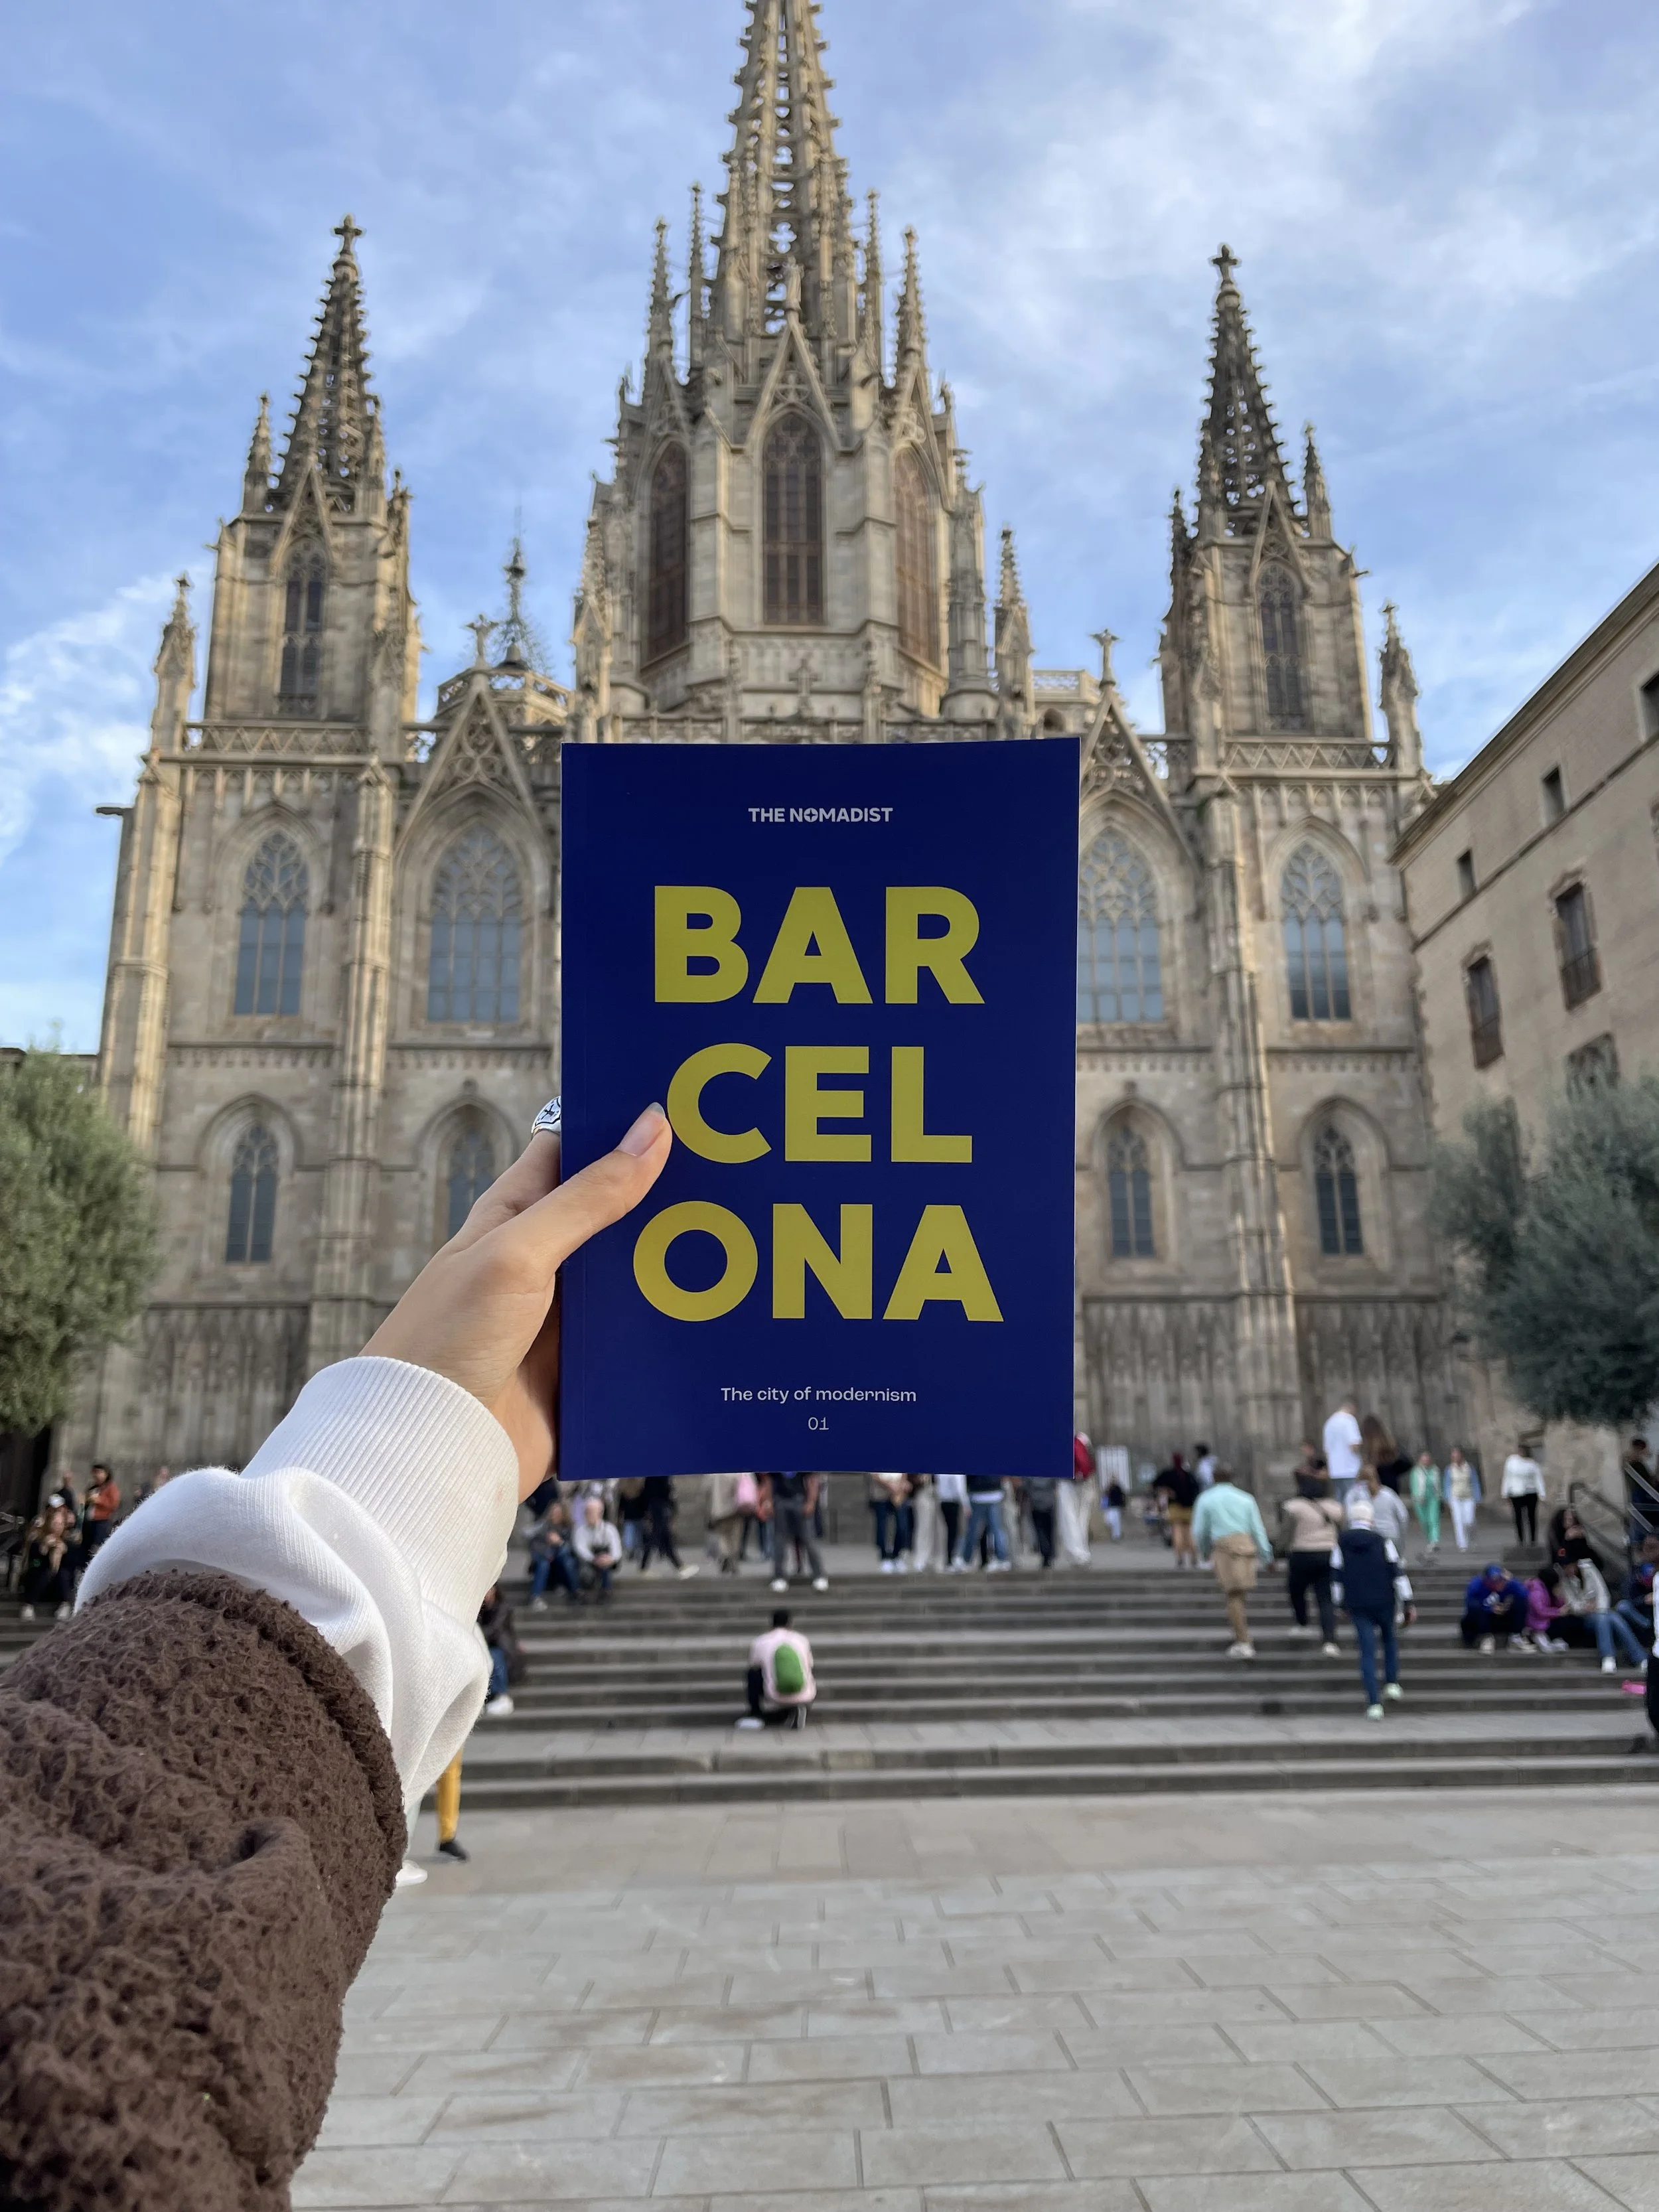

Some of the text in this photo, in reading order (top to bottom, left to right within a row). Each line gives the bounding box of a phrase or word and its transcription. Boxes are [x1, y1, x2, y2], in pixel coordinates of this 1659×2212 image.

[748, 807, 893, 823] THE NOMADIST
[654, 885, 985, 1004] BAR
[666, 1043, 973, 1163] CEL
[633, 1201, 1004, 1322] ONA
[720, 1386, 916, 1404] The city of modernism
[808, 1416, 830, 1431] 01
